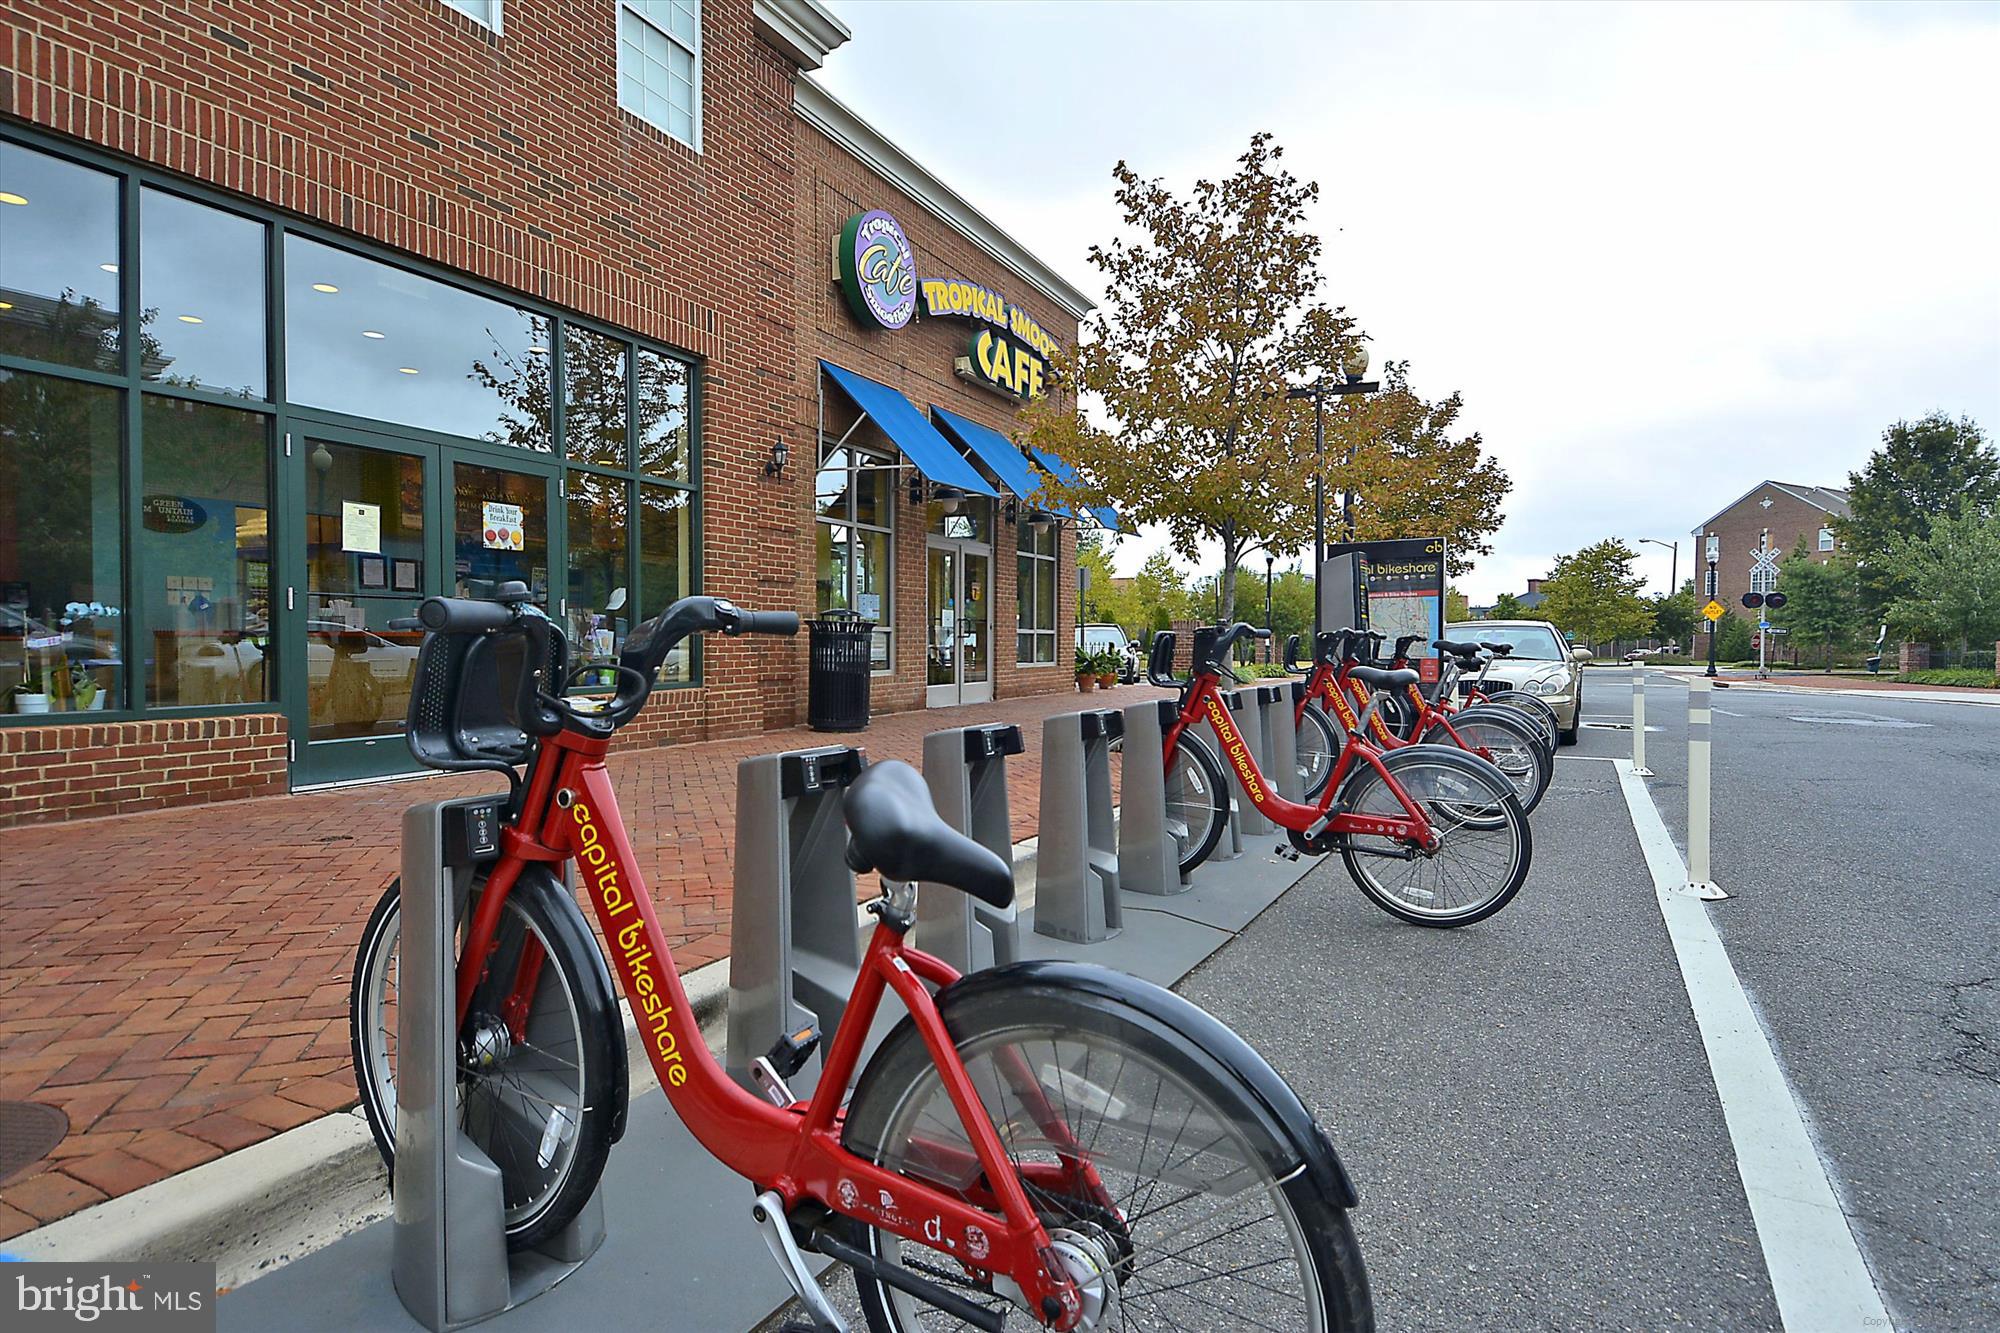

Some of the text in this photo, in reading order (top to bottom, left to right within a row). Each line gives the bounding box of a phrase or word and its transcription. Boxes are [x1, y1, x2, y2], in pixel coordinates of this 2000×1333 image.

[861, 218, 910, 260] Tropical
[865, 284, 911, 324] Smoothie
[923, 280, 1007, 325] TROPICAL
[977, 329, 1043, 397] CAFE
[143, 505, 193, 516] MUNTAIN
[153, 499, 184, 508] GREEN
[489, 504, 518, 516] Drink Your
[490, 513, 517, 524] Breakfast
[1377, 563, 1436, 575] bikeshare
[1326, 681, 1347, 709] capital
[1207, 701, 1264, 803] capital bikeshare
[573, 802, 688, 1088] capital bikeshare
